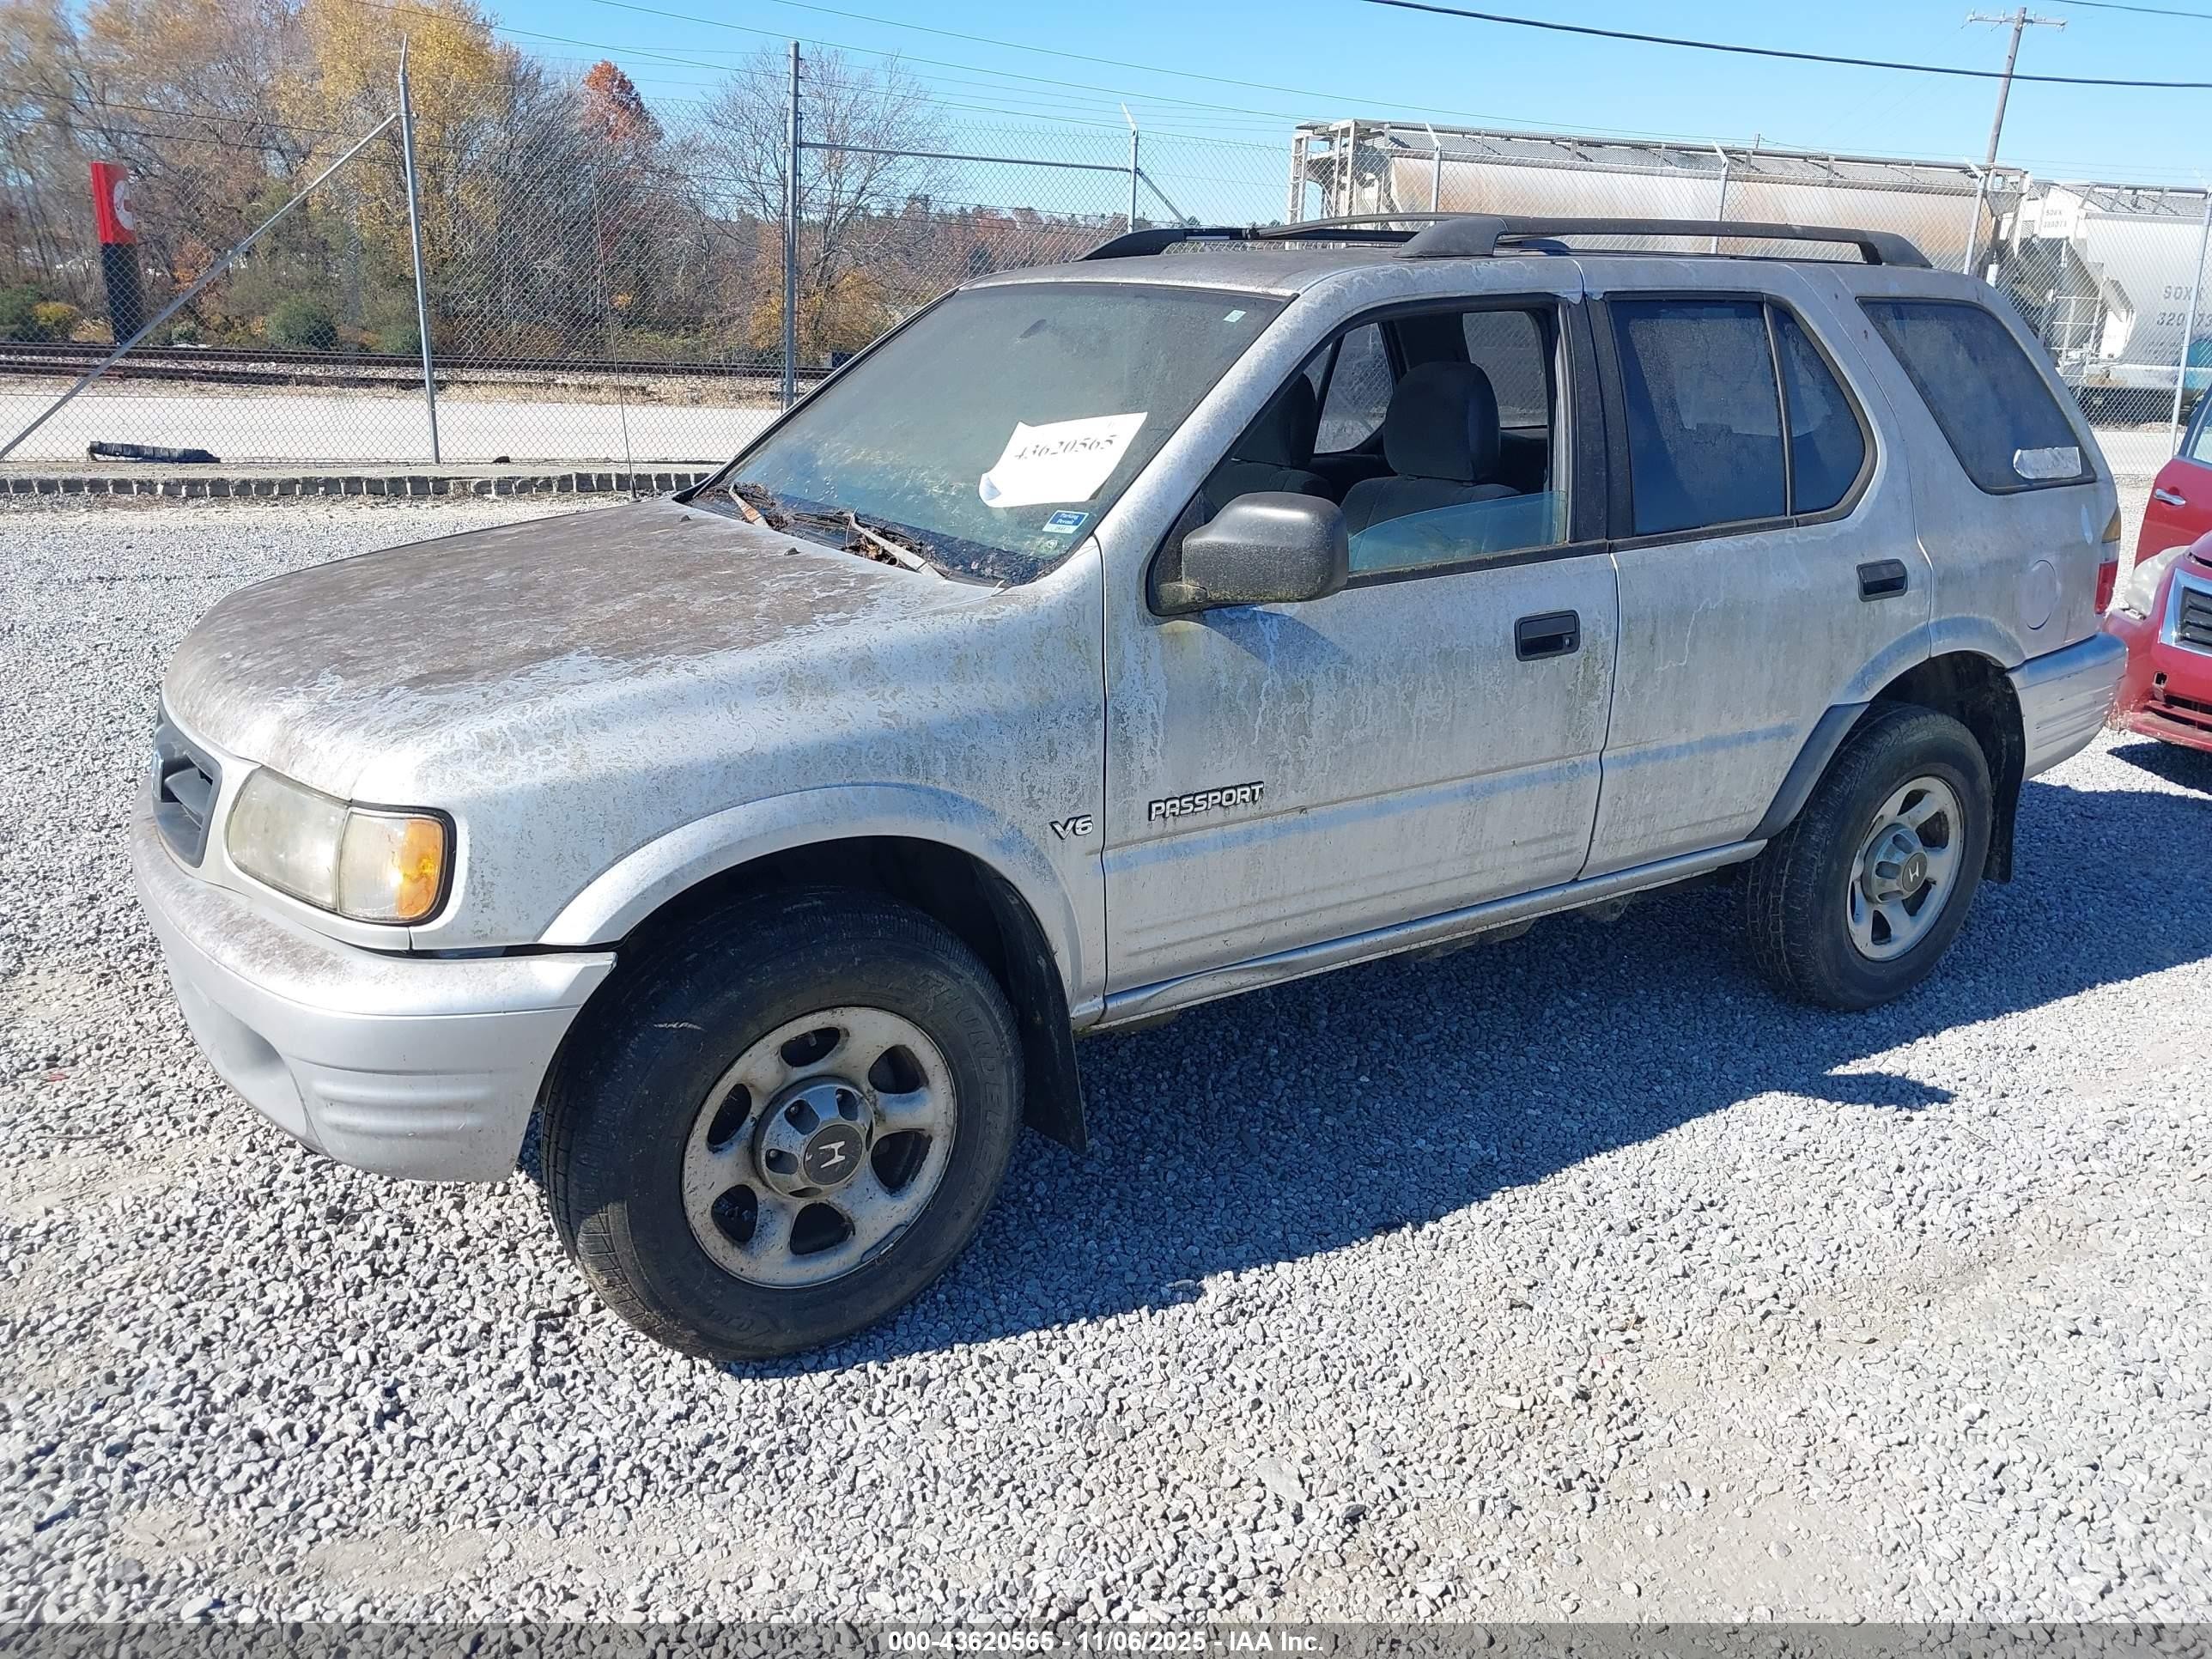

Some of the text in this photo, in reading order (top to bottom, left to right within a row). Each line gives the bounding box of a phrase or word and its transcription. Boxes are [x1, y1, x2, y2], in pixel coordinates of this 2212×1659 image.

[2156, 312, 2212, 327] 32073
[1013, 434, 1117, 460] 43620565
[1148, 781, 1265, 822] PASSPORT
[1049, 814, 1094, 841] V6
